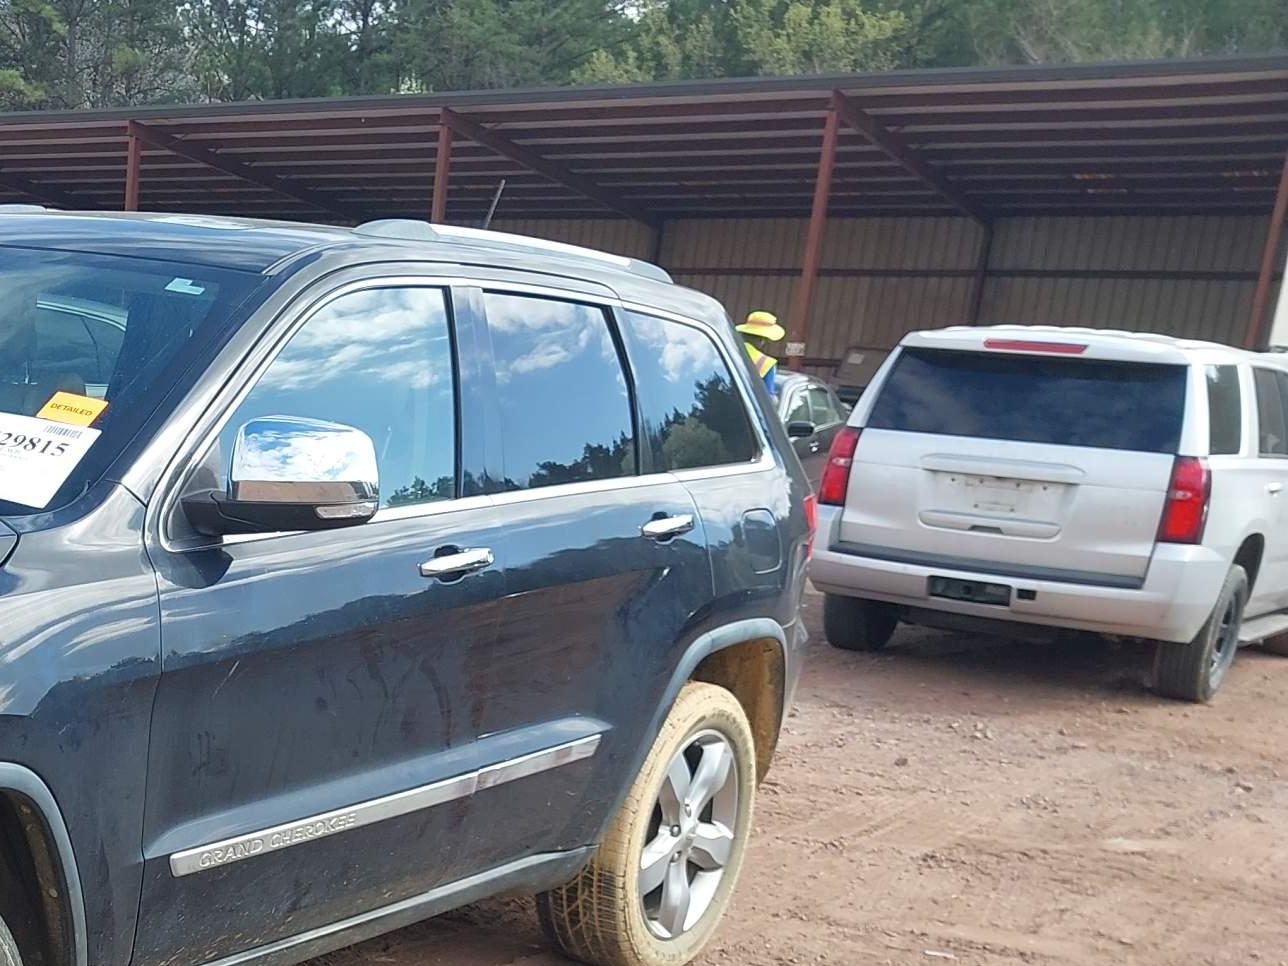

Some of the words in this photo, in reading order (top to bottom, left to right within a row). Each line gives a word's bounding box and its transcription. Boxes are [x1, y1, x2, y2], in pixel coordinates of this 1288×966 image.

[50, 402, 93, 416] DETAILED
[199, 839, 264, 867] GRAND
[269, 813, 357, 848] CHEROKEE
